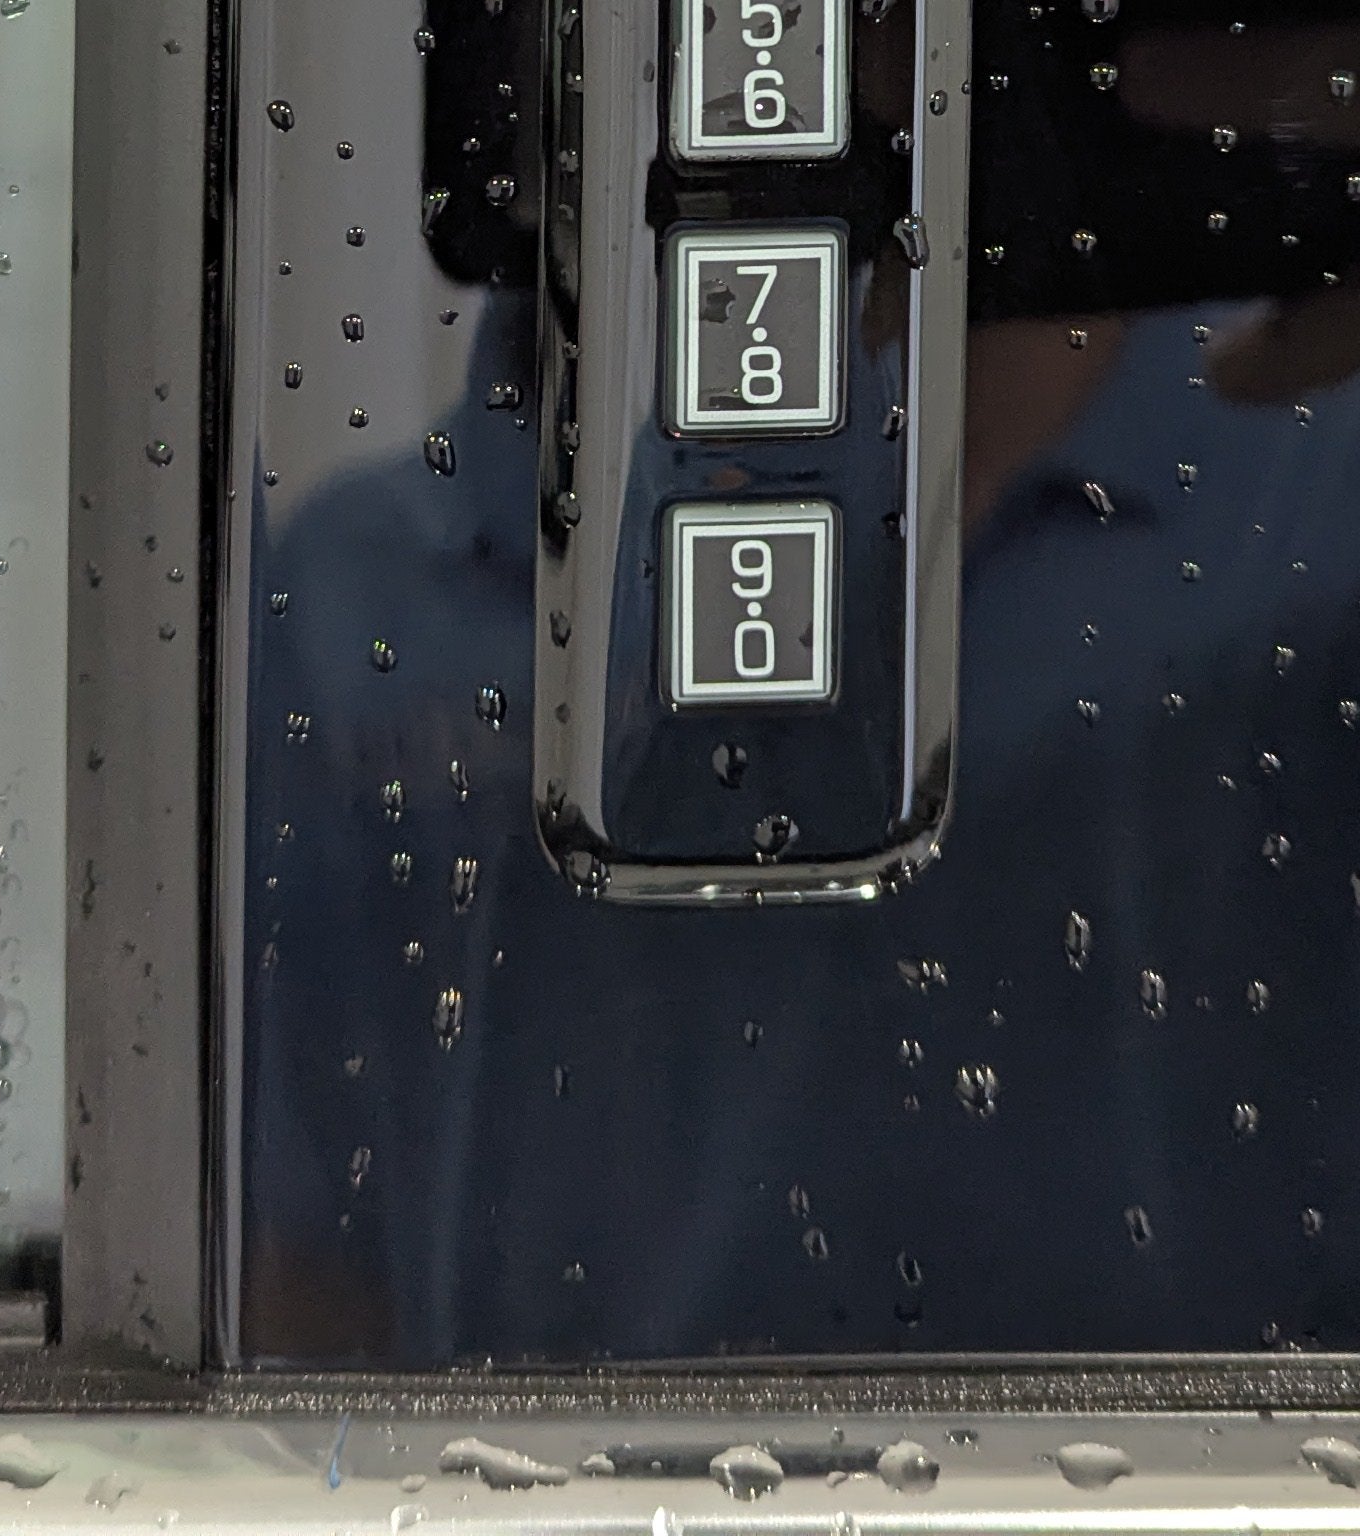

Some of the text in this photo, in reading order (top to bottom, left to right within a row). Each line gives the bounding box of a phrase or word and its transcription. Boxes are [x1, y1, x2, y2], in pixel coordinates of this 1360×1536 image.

[743, 69, 786, 129] 6
[736, 265, 778, 325] 7
[741, 345, 783, 404] 8
[731, 540, 773, 599] 9
[734, 621, 776, 679] 0
